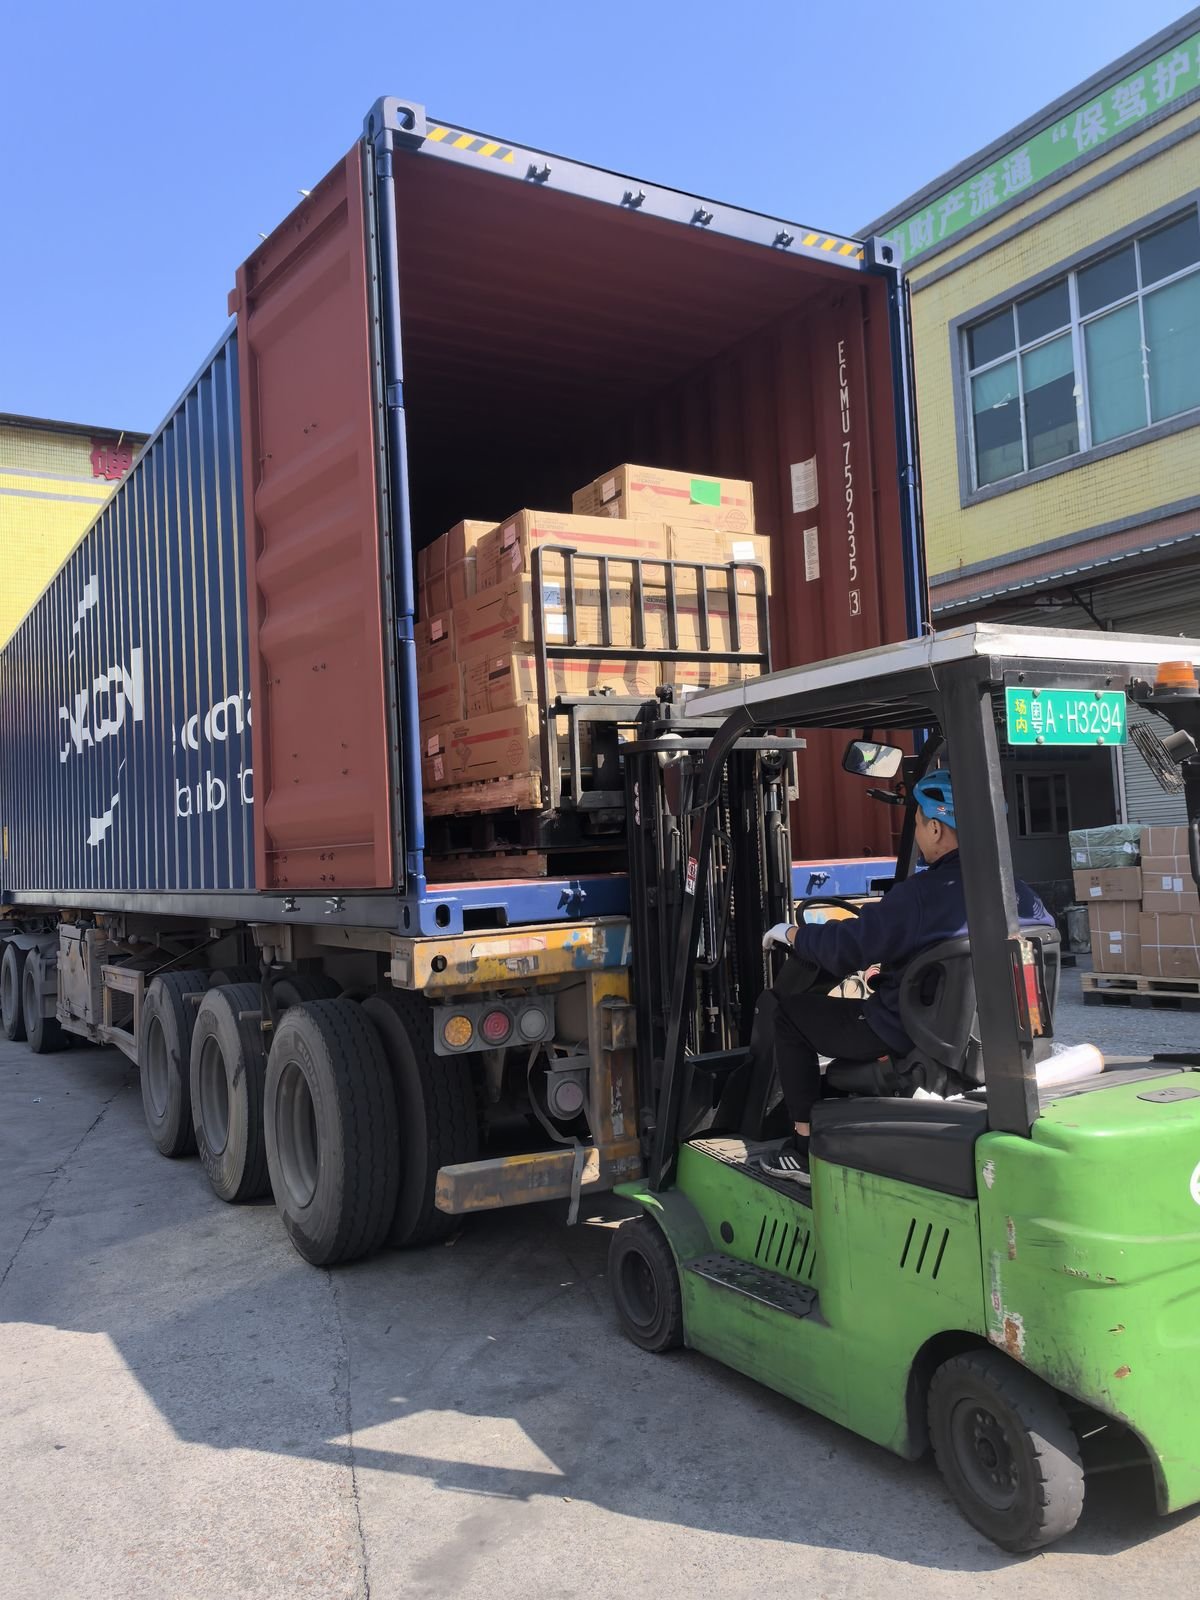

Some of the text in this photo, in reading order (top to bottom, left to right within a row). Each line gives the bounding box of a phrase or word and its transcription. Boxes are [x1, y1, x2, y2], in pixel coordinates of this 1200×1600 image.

[1051, 43, 1200, 152] “保驾护
[837, 340, 861, 616] ECMU 759335 3
[1014, 698, 1028, 734] 场内
[1030, 699, 1122, 734] 粤A·H3294
